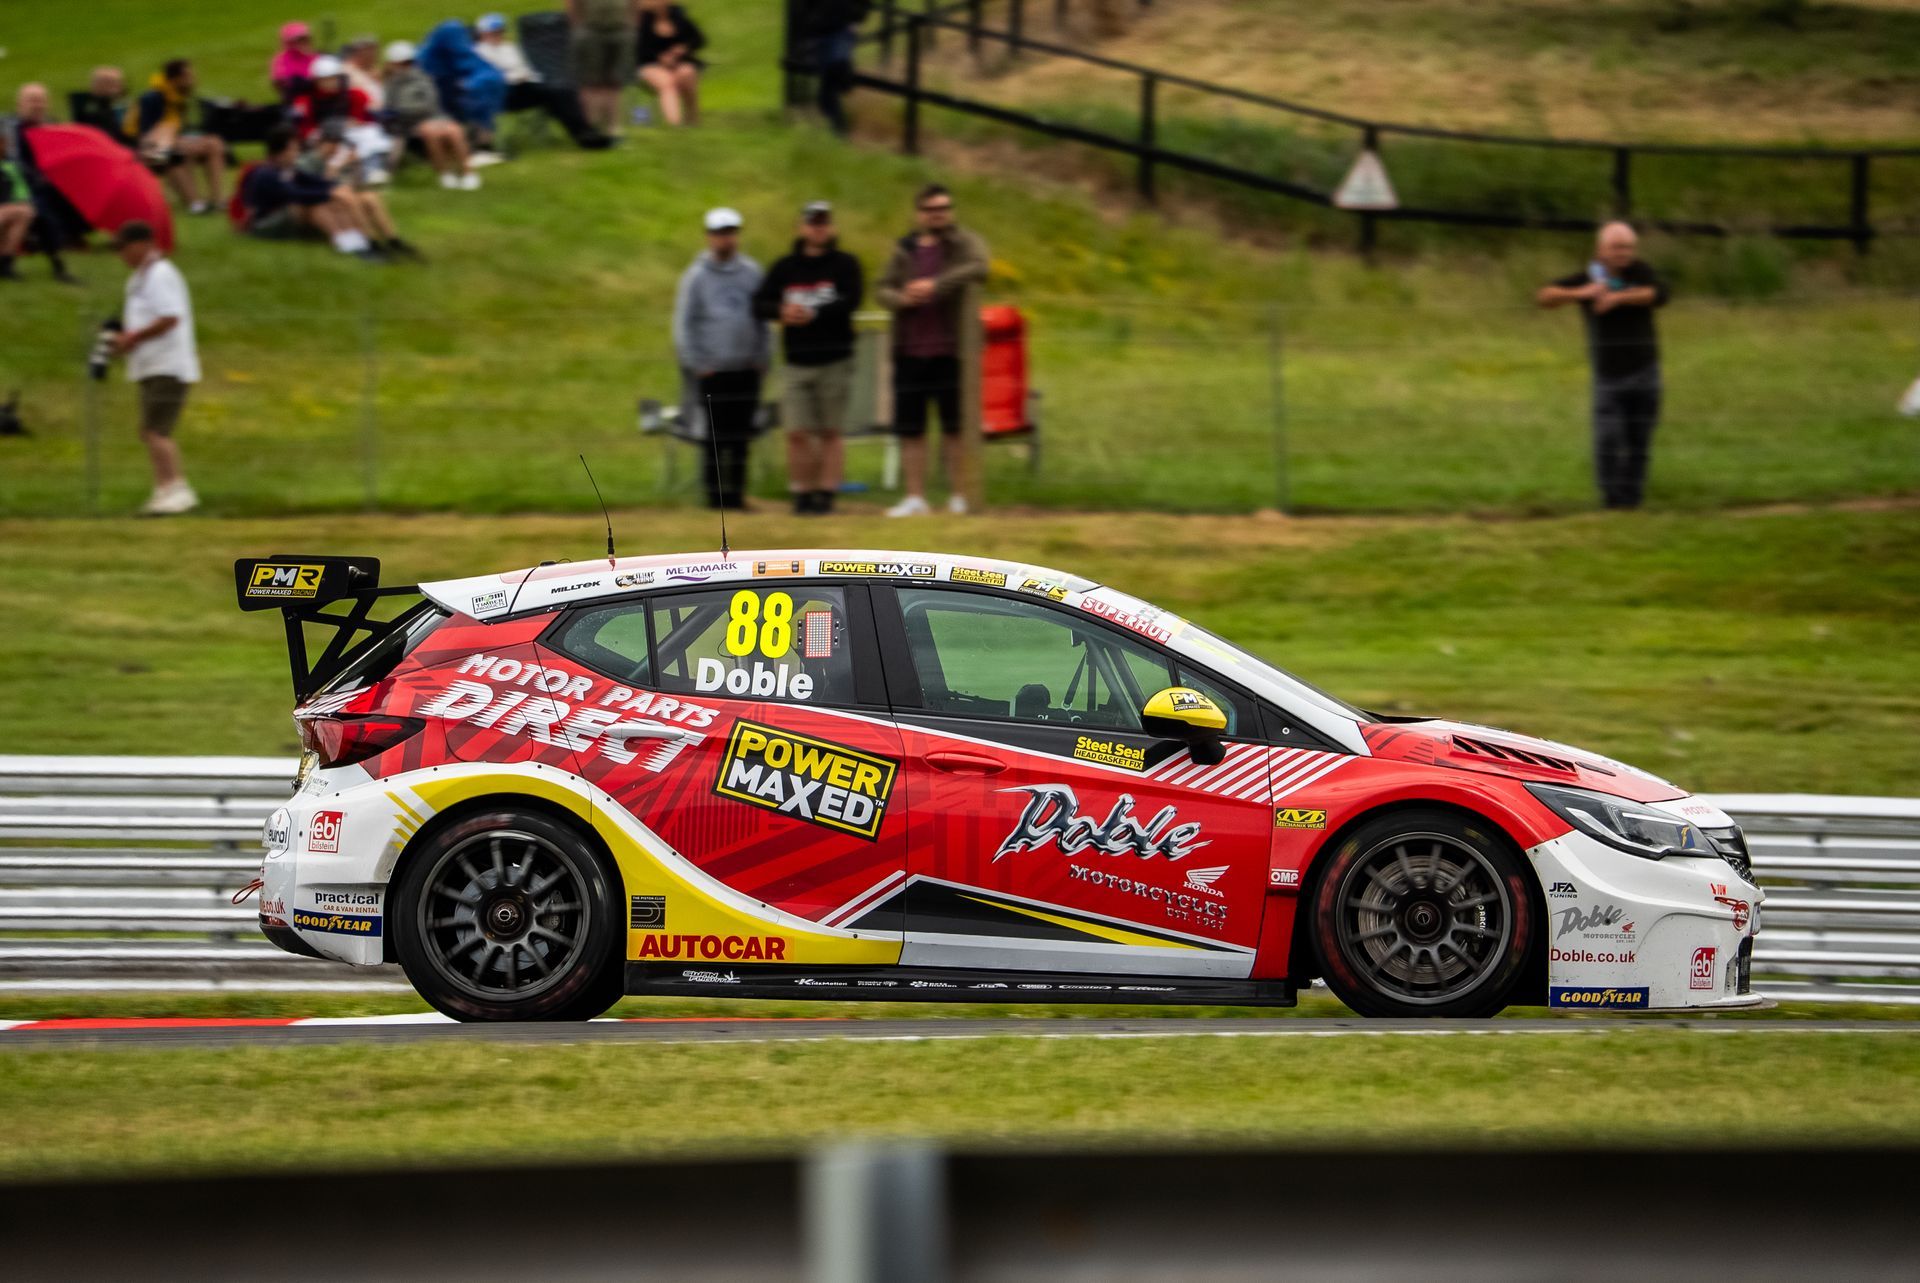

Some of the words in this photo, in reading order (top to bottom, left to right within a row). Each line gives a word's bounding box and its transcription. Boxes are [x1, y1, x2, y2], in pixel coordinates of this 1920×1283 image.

[253, 567, 316, 586] PMR
[666, 562, 737, 576] METAMARK
[823, 563, 876, 573] POWER
[878, 562, 932, 577] MAXED
[953, 567, 980, 576] Steel
[982, 571, 1006, 580] Seal
[726, 590, 793, 658] 88
[695, 657, 814, 700] Doble
[457, 653, 593, 700] MOTOR
[599, 686, 720, 727] PARTS
[415, 679, 707, 773] DIRECT
[1075, 749, 1097, 759] HEAD
[1097, 753, 1128, 765] GASKET
[1076, 736, 1113, 754] Steel
[1114, 743, 1145, 760] Seal
[736, 730, 882, 797] POWER
[727, 758, 873, 825] MAXED
[309, 812, 341, 840] febi
[992, 783, 1213, 863] Doble
[268, 827, 289, 843] eurol
[311, 841, 334, 850] bilstein
[1271, 872, 1299, 883] OMP
[1070, 863, 1228, 918] MOTORCYCLES
[1183, 881, 1225, 898] HONDA
[1549, 882, 1578, 892] JFA
[1717, 884, 1726, 895] TOW
[315, 893, 379, 904] practical
[294, 914, 372, 932] GOODYEAR
[1552, 905, 1627, 940] Doble
[639, 935, 786, 960] AUTOCAR
[1551, 948, 1635, 963] Doble.co.uk
[1691, 949, 1715, 977] febi
[1693, 978, 1711, 987] bilstein
[1560, 989, 1642, 1006] GOODYEAR
